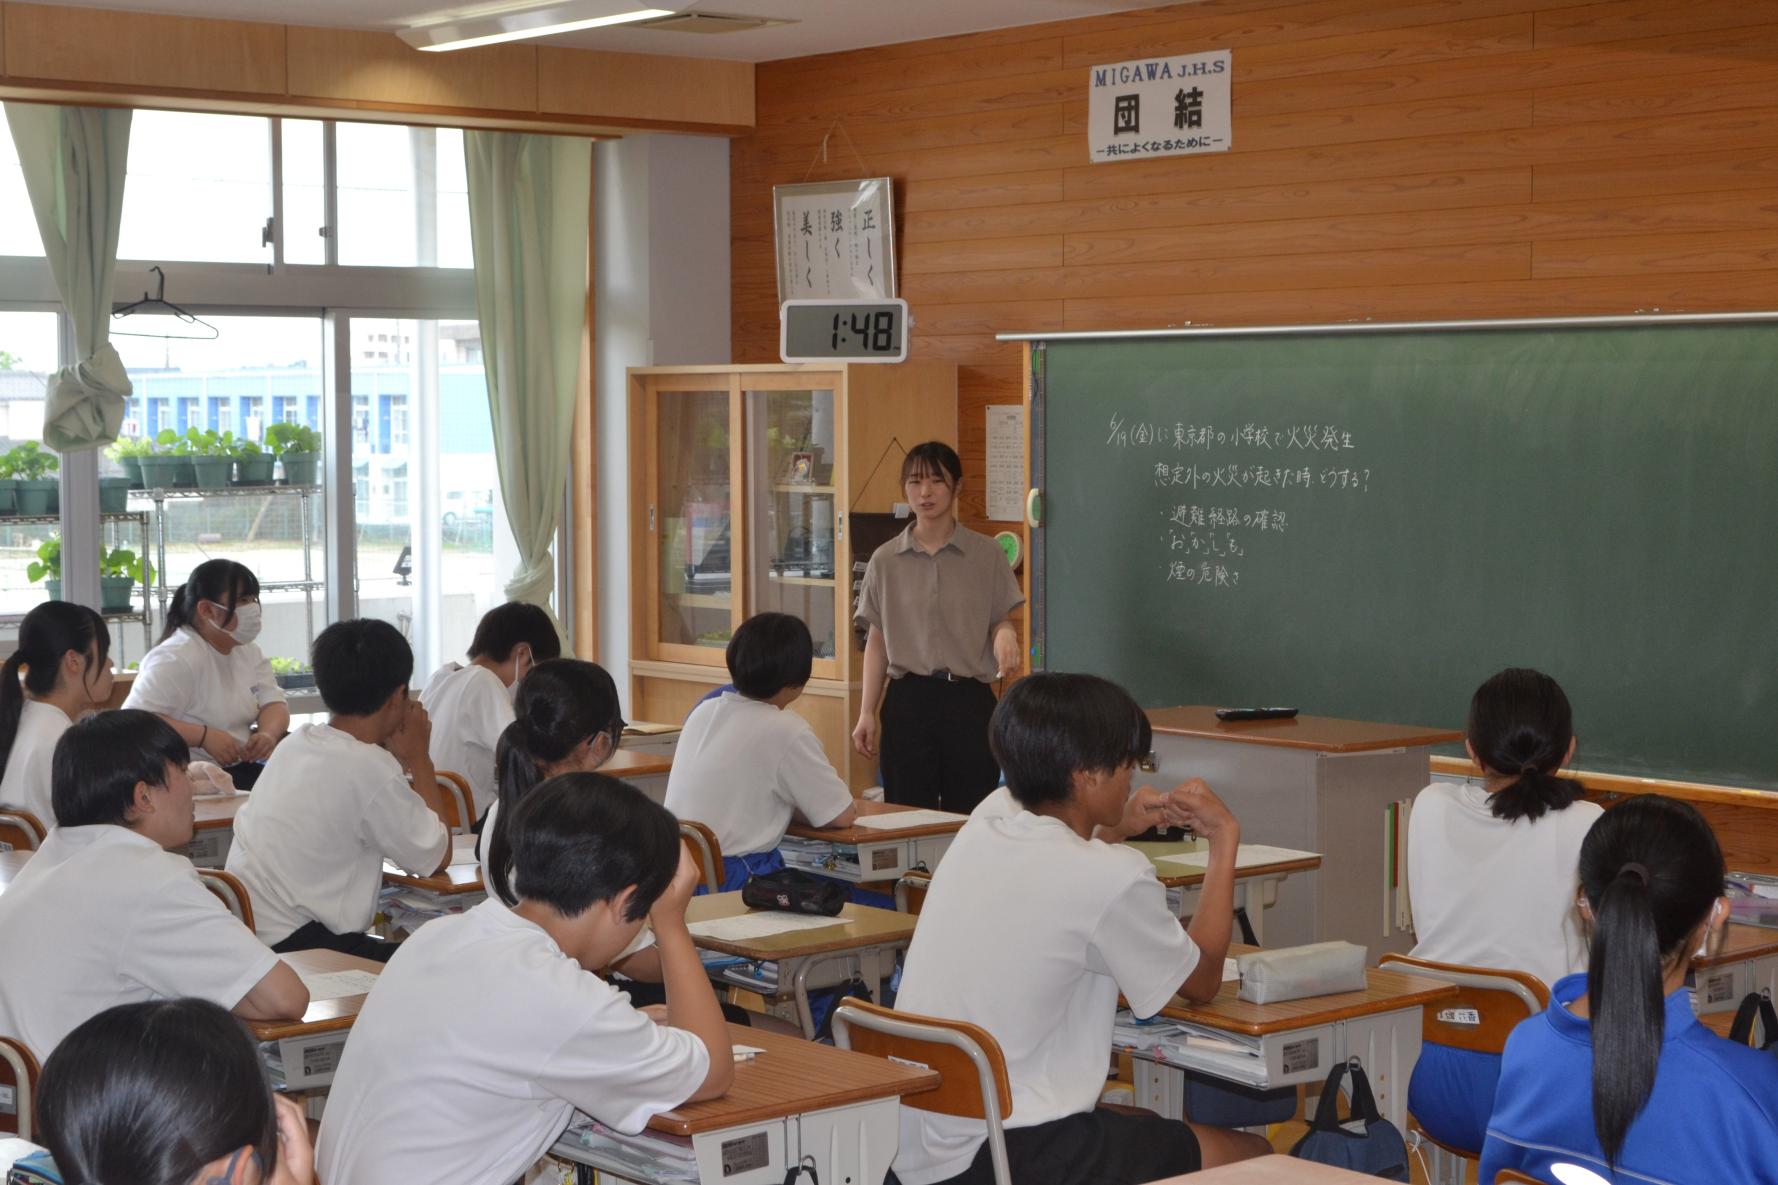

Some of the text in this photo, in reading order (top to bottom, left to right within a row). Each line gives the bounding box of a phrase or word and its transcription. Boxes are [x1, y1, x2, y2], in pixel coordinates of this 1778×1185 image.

[1095, 60, 1225, 87] MIGAWA J.H.S
[800, 211, 813, 288] 美しく
[830, 209, 844, 259] 強く
[862, 209, 876, 286] 正しく
[831, 311, 894, 350] 1:48
